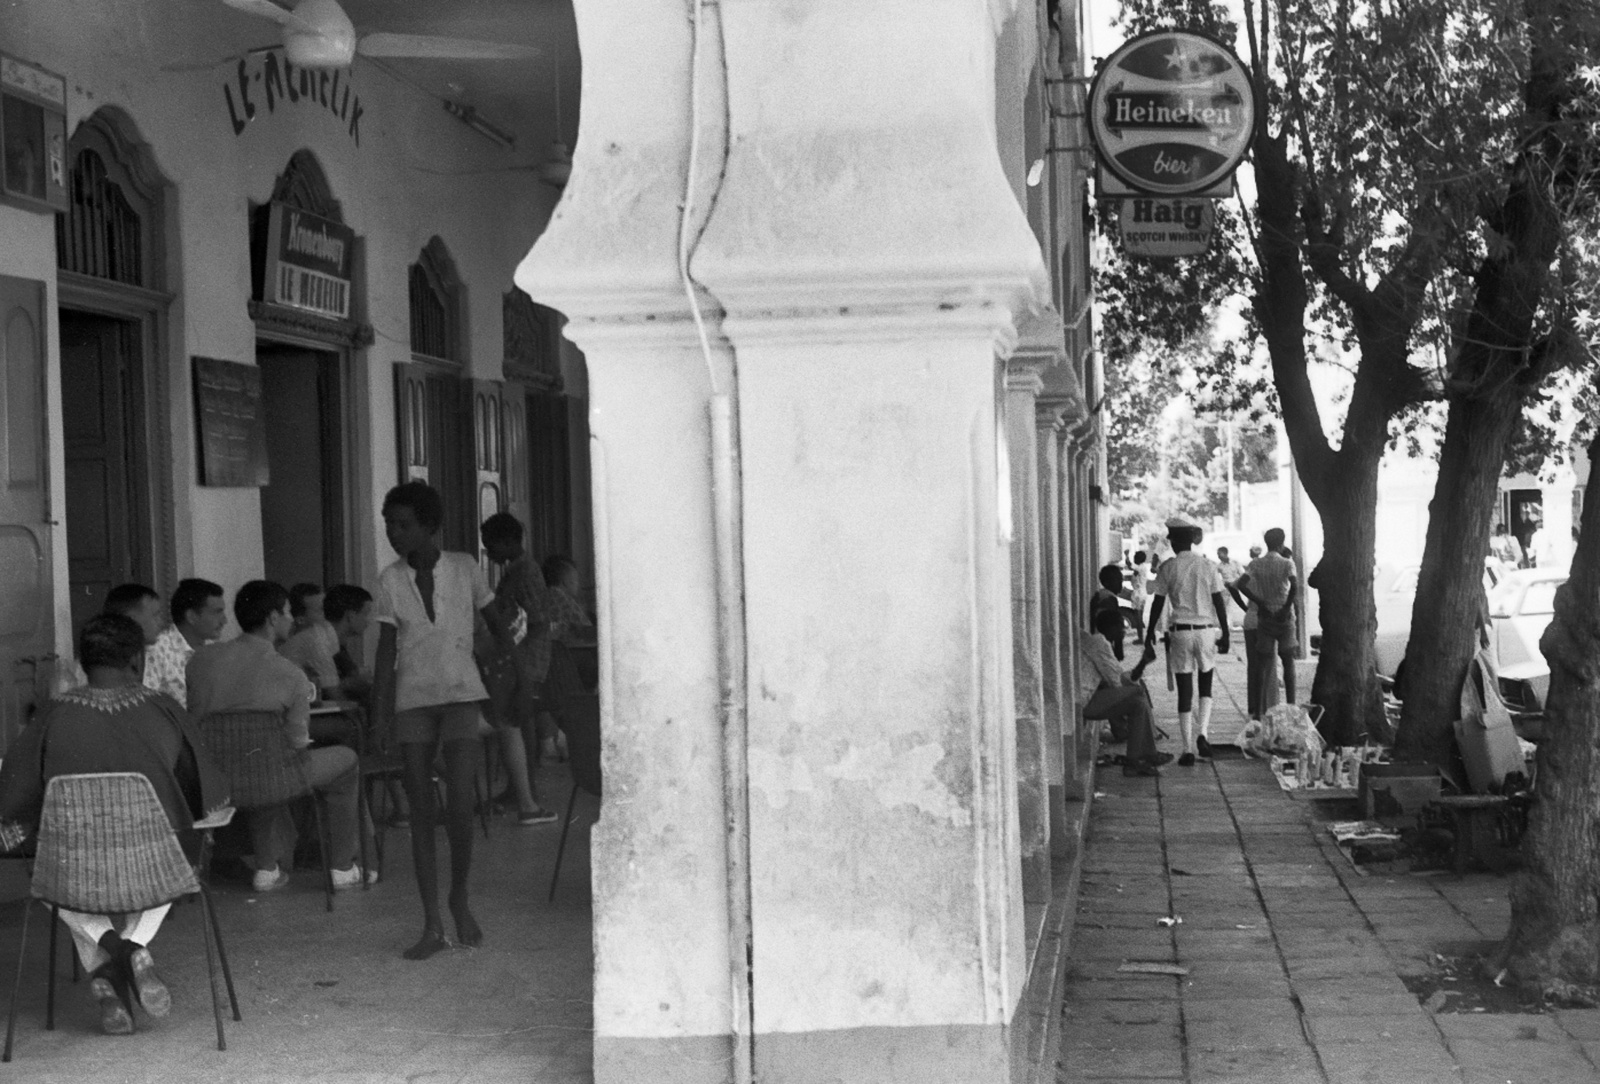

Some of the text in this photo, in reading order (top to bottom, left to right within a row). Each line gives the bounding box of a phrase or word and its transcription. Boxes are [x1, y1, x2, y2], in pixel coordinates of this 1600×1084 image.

[1115, 97, 1232, 125] Heineken
[1153, 150, 1192, 175] bier
[1132, 200, 1204, 230] Haig
[1126, 231, 1208, 243] SCOTCH WHISKY
